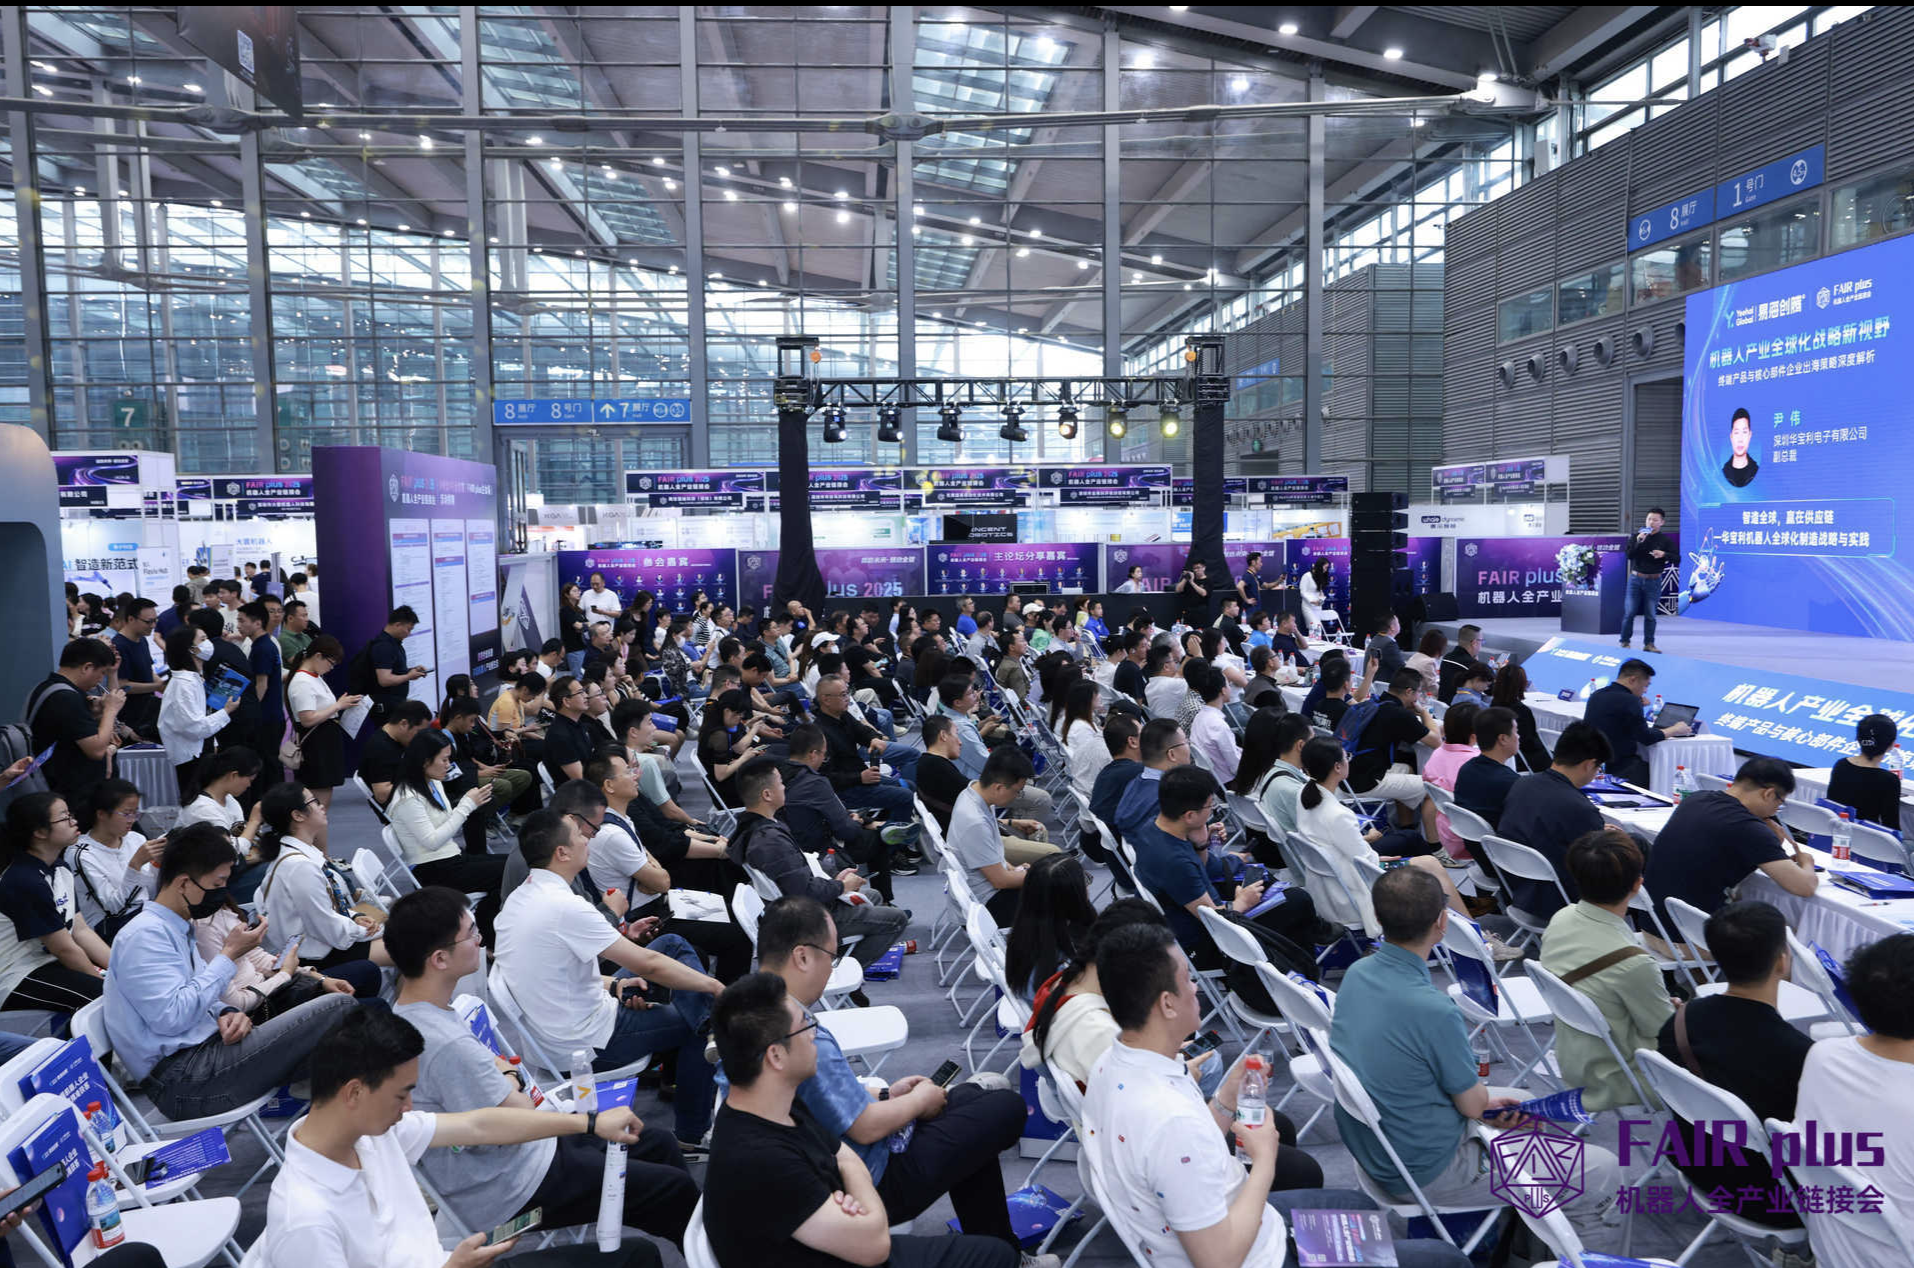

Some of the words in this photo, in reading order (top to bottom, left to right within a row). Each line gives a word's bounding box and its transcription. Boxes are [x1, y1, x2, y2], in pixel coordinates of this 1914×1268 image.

[1733, 182, 1743, 207] 1
[1746, 174, 1764, 192] 号门
[1670, 207, 1679, 230] 8
[1681, 200, 1697, 216] 展厅
[1833, 281, 1853, 296] FAIR
[1854, 278, 1872, 292] plus
[1709, 315, 1890, 369] 机器人产业全球化战略新视野
[121, 408, 135, 426] 7
[504, 404, 516, 419] 8
[518, 404, 535, 412] 展厅
[551, 403, 562, 419] 8
[564, 403, 582, 412] 号门
[619, 403, 628, 418] 7
[632, 403, 650, 412] 展厅
[1774, 426, 1868, 447] 深圳华宝利电子有限公司
[1742, 510, 1834, 526] 智造全球，赢在供应链
[75, 558, 138, 570] 智造新范式
[1478, 571, 1519, 586] FAIR
[1525, 568, 1564, 587] plus
[828, 580, 858, 596] lus
[864, 582, 903, 596] 2025
[1478, 591, 1562, 604] 机器人全产业
